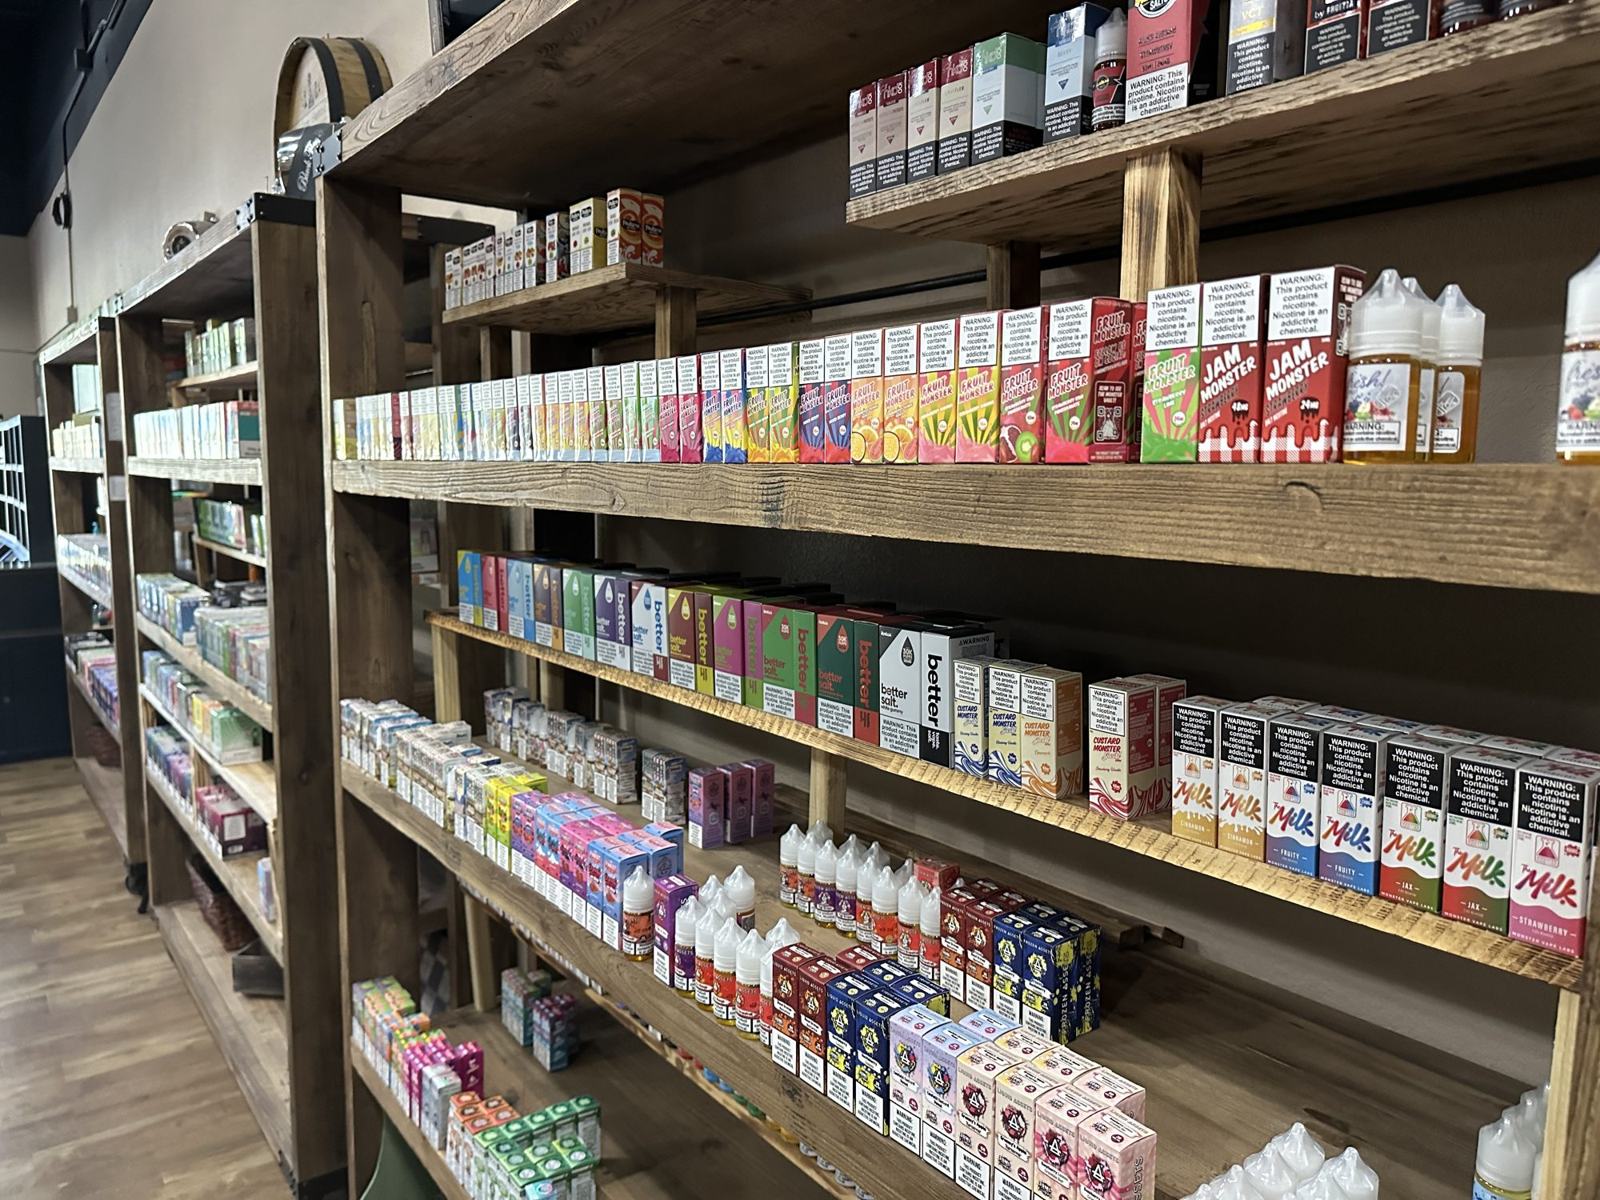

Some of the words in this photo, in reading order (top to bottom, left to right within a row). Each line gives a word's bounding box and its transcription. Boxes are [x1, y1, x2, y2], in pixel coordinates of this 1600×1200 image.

[1130, 74, 1166, 90] WARNING:
[1168, 71, 1183, 79] This
[1128, 85, 1154, 100] product
[1155, 77, 1185, 91] contains
[1128, 94, 1156, 106] nicotine.
[1157, 85, 1186, 97] Nicotine
[1149, 94, 1180, 107] addictive
[1140, 102, 1173, 117] chemical.
[1280, 274, 1323, 286] WARNING:
[1212, 282, 1250, 294] WARNING:
[1276, 287, 1293, 295] This
[1295, 282, 1329, 294] product
[1155, 290, 1192, 301] WARNING:
[1225, 290, 1255, 301] product
[1283, 293, 1319, 302] contains
[1168, 298, 1196, 308] product
[1215, 300, 1247, 310] contains
[1283, 301, 1319, 310] nicotine.
[1158, 307, 1188, 316] contains
[1215, 308, 1247, 317] nicotine.
[1273, 311, 1306, 320] Nicotine
[1318, 308, 1329, 316] an
[1096, 310, 1125, 332] FRUIT
[1158, 315, 1188, 324] nicotine.
[1206, 317, 1236, 326] Nicotine
[1281, 318, 1319, 328] addictive
[1093, 322, 1130, 345] MONSTER
[1150, 324, 1178, 332] Nicotine
[1156, 330, 1188, 339] addictive
[1213, 324, 1247, 334] addictive
[1280, 325, 1319, 336] chemical.
[1155, 337, 1188, 347] chemical.
[1212, 331, 1248, 342] chemical.
[1204, 344, 1242, 384] JAM
[1270, 339, 1312, 381] JAM
[1149, 354, 1187, 380] FRUIT
[1003, 368, 1032, 393] FRUIT
[1050, 362, 1081, 387] FRUIT
[1144, 365, 1195, 394] MONSTER
[1200, 356, 1257, 403] MONSTER
[1265, 352, 1329, 400] MONSTER
[922, 375, 947, 397] FRUIT
[961, 371, 989, 393] FRUIT
[1047, 373, 1088, 400] MONSTER
[920, 385, 953, 407] MONSTER
[959, 381, 995, 403] MONSTER
[1001, 379, 1039, 404] MONSTER
[617, 592, 626, 644] better
[653, 600, 664, 654] better
[698, 608, 707, 666] better
[963, 636, 990, 645] WARNING
[797, 628, 809, 690] better
[859, 639, 873, 708] better
[881, 683, 908, 700] better
[927, 653, 943, 727] better
[881, 695, 899, 708] salt.
[992, 720, 1017, 728] MONSTER
[1275, 733, 1288, 742] This
[1289, 737, 1315, 747] product
[1278, 727, 1312, 740] WARNING:
[1093, 736, 1121, 745] CUSTARD
[1280, 742, 1308, 752] contains
[1331, 738, 1369, 751] WARNING:
[1093, 744, 1121, 753] MONSTER
[1280, 748, 1308, 758] nicotine.
[1329, 744, 1343, 753] This
[1344, 749, 1372, 759] product
[1273, 752, 1299, 763] Nicotine
[1335, 754, 1365, 764] contains
[1396, 748, 1436, 763] WARNING:
[1279, 760, 1308, 771] addictive
[1334, 760, 1364, 771] nicotine.
[1392, 754, 1407, 764] This
[1409, 760, 1439, 771] product
[1278, 766, 1309, 778] chemical.
[1326, 763, 1354, 776] Nicotine
[1399, 764, 1431, 776] contains
[1460, 763, 1505, 778] WARNING:
[1333, 773, 1365, 784] addictive
[1389, 774, 1420, 788] Nicotine
[1421, 782, 1428, 790] is
[1398, 771, 1430, 783] nicotine.
[1456, 769, 1473, 780] This
[1476, 775, 1509, 787] product
[1332, 779, 1365, 791] chemical.
[1464, 780, 1500, 792] contains
[1528, 776, 1576, 792] WARNING:
[1173, 781, 1213, 810] Milk
[1396, 791, 1431, 804] chemical.
[1397, 785, 1430, 797] addictive
[1464, 787, 1499, 799] nicotine.
[1525, 783, 1542, 794] This
[1545, 788, 1580, 801] product
[1453, 790, 1487, 804] Nicotine
[1489, 798, 1497, 806] is
[1498, 801, 1509, 809] an
[1532, 793, 1570, 807] contains
[1221, 793, 1262, 822] Milk
[1460, 807, 1500, 821] chemical.
[1462, 801, 1499, 814] addictive
[1522, 804, 1557, 819] Nicotine
[1559, 813, 1567, 822] is
[1532, 801, 1570, 814] nicotine.
[1269, 805, 1314, 837] Milk
[1530, 816, 1570, 830] addictive
[1322, 820, 1371, 853] Milk
[1529, 822, 1571, 838] chemical.
[1280, 849, 1300, 860] FRUITY
[1383, 835, 1436, 869] Milk
[1334, 864, 1356, 876] FRUITY
[1446, 853, 1506, 888] Milk
[1515, 869, 1578, 908] Milk
[1468, 901, 1481, 912] JAX
[1519, 916, 1568, 937] STRAWBERRY
